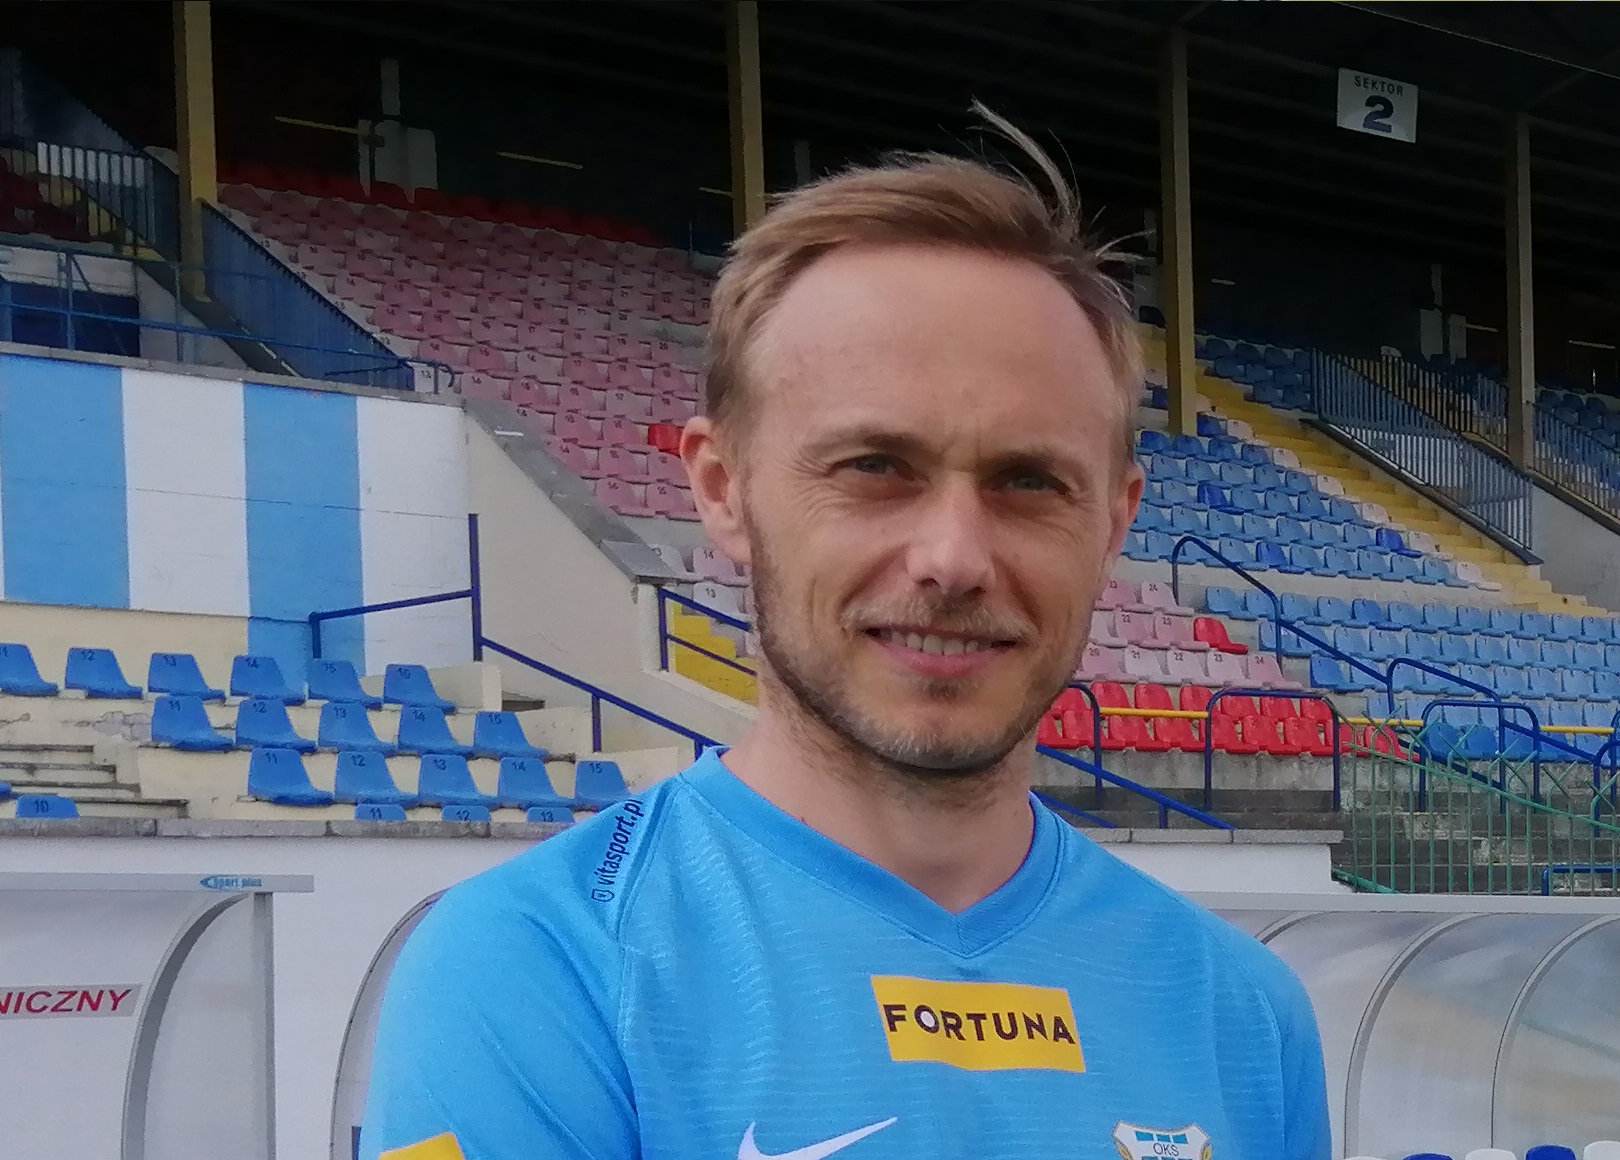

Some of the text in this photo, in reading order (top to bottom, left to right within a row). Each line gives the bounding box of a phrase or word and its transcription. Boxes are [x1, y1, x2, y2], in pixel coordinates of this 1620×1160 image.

[1353, 75, 1404, 96] SEKTOR
[1362, 94, 1394, 134] 2
[1174, 653, 1184, 661] 22
[264, 751, 280, 764] 11
[350, 754, 366, 767] 12
[511, 760, 527, 773] 14
[589, 762, 603, 775] 15
[592, 799, 645, 886] vitasport.pl
[882, 1004, 1076, 1045] FORTUNA
[1153, 1142, 1180, 1157] OKS
